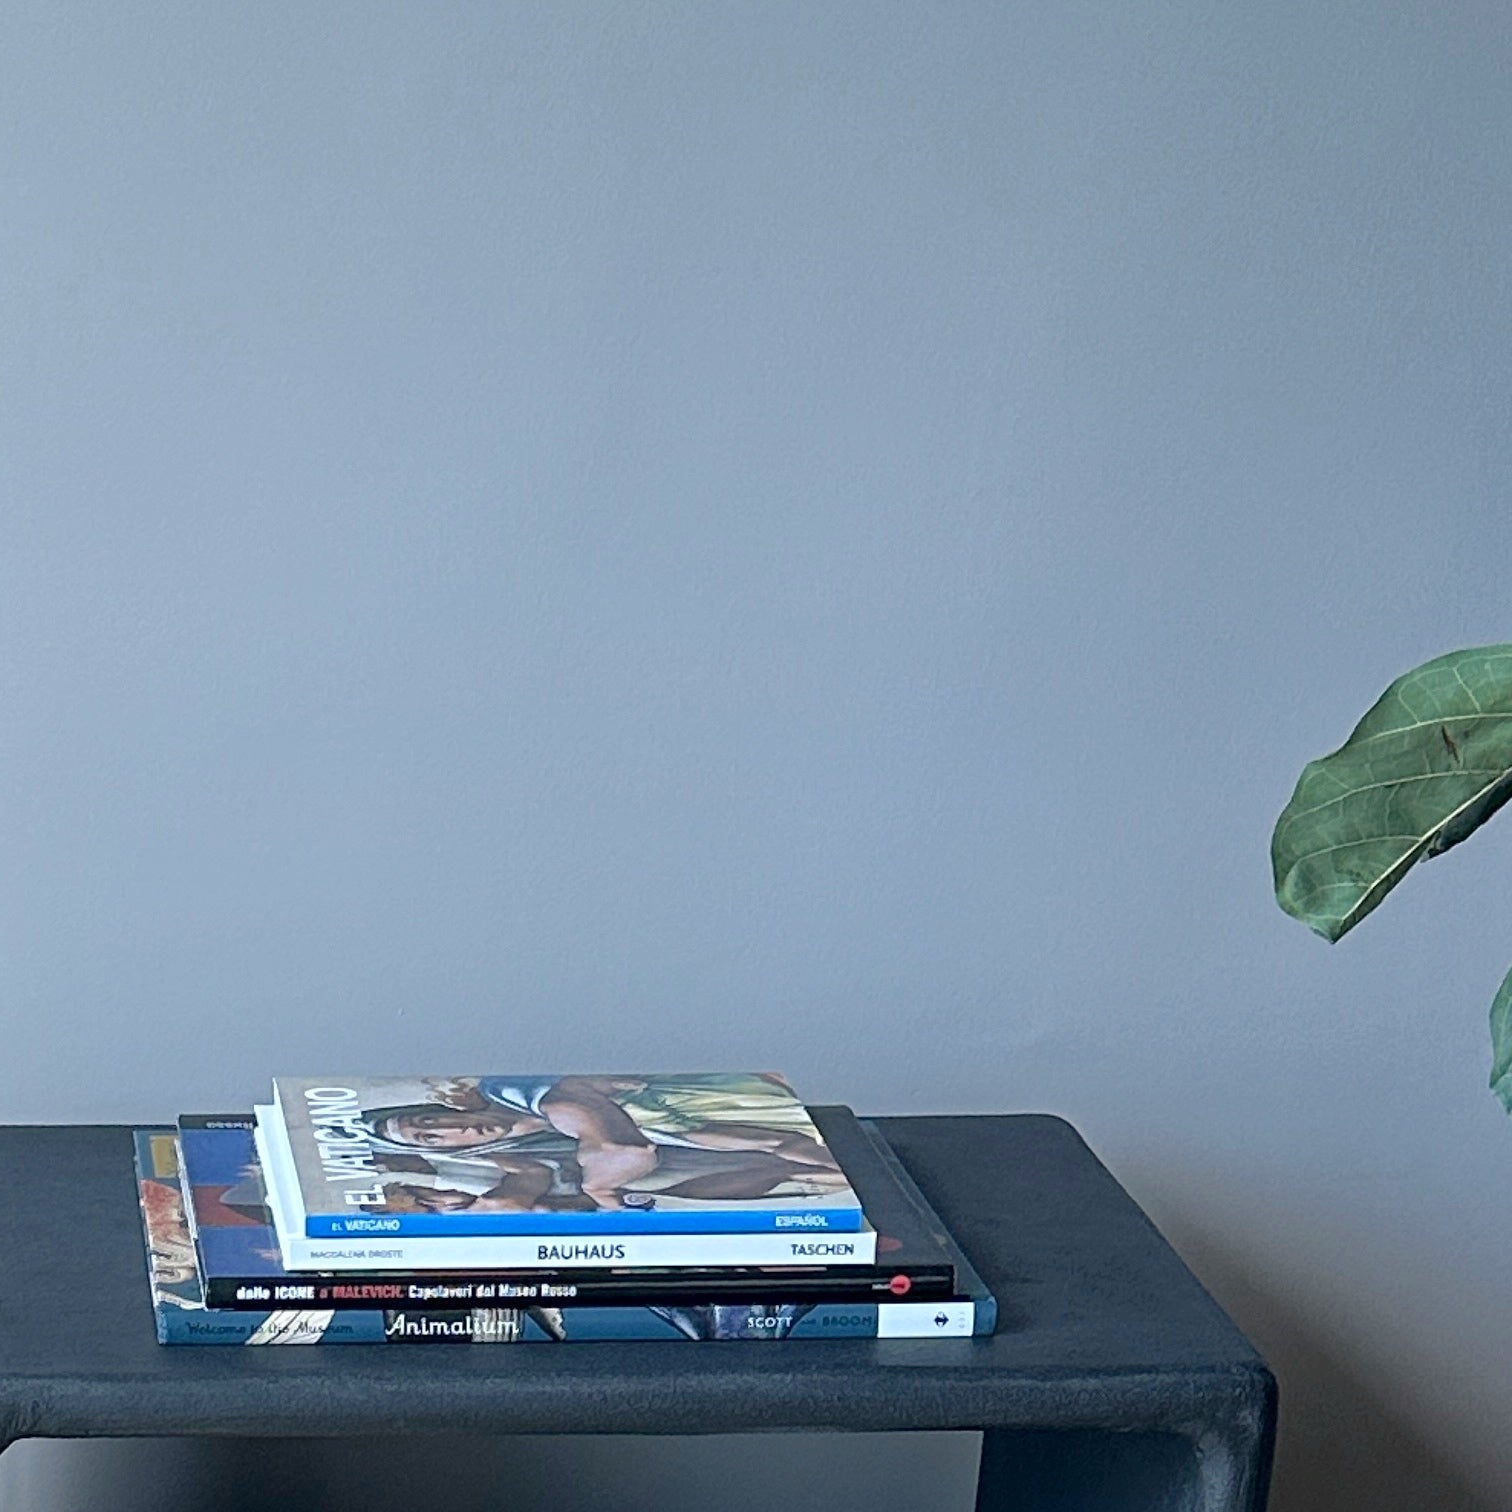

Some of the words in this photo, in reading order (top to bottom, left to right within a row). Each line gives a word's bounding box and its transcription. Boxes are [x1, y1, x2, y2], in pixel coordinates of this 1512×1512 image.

[304, 1087, 380, 1182] VATICANO
[343, 1184, 386, 1205] EL
[345, 1219, 400, 1232] VATICANO
[775, 1212, 829, 1227] ESPAÑOL
[537, 1244, 626, 1260] BAUHAUS
[791, 1243, 855, 1256] TASCHEN
[274, 1286, 315, 1299] ICONE
[499, 1284, 537, 1297] Museo
[540, 1284, 577, 1297] Russo
[185, 1321, 246, 1335] Welcome
[293, 1320, 355, 1335] Museum
[385, 1313, 520, 1337] Animalium
[747, 1315, 793, 1328] SCOTT
[822, 1314, 873, 1328] BROOM
